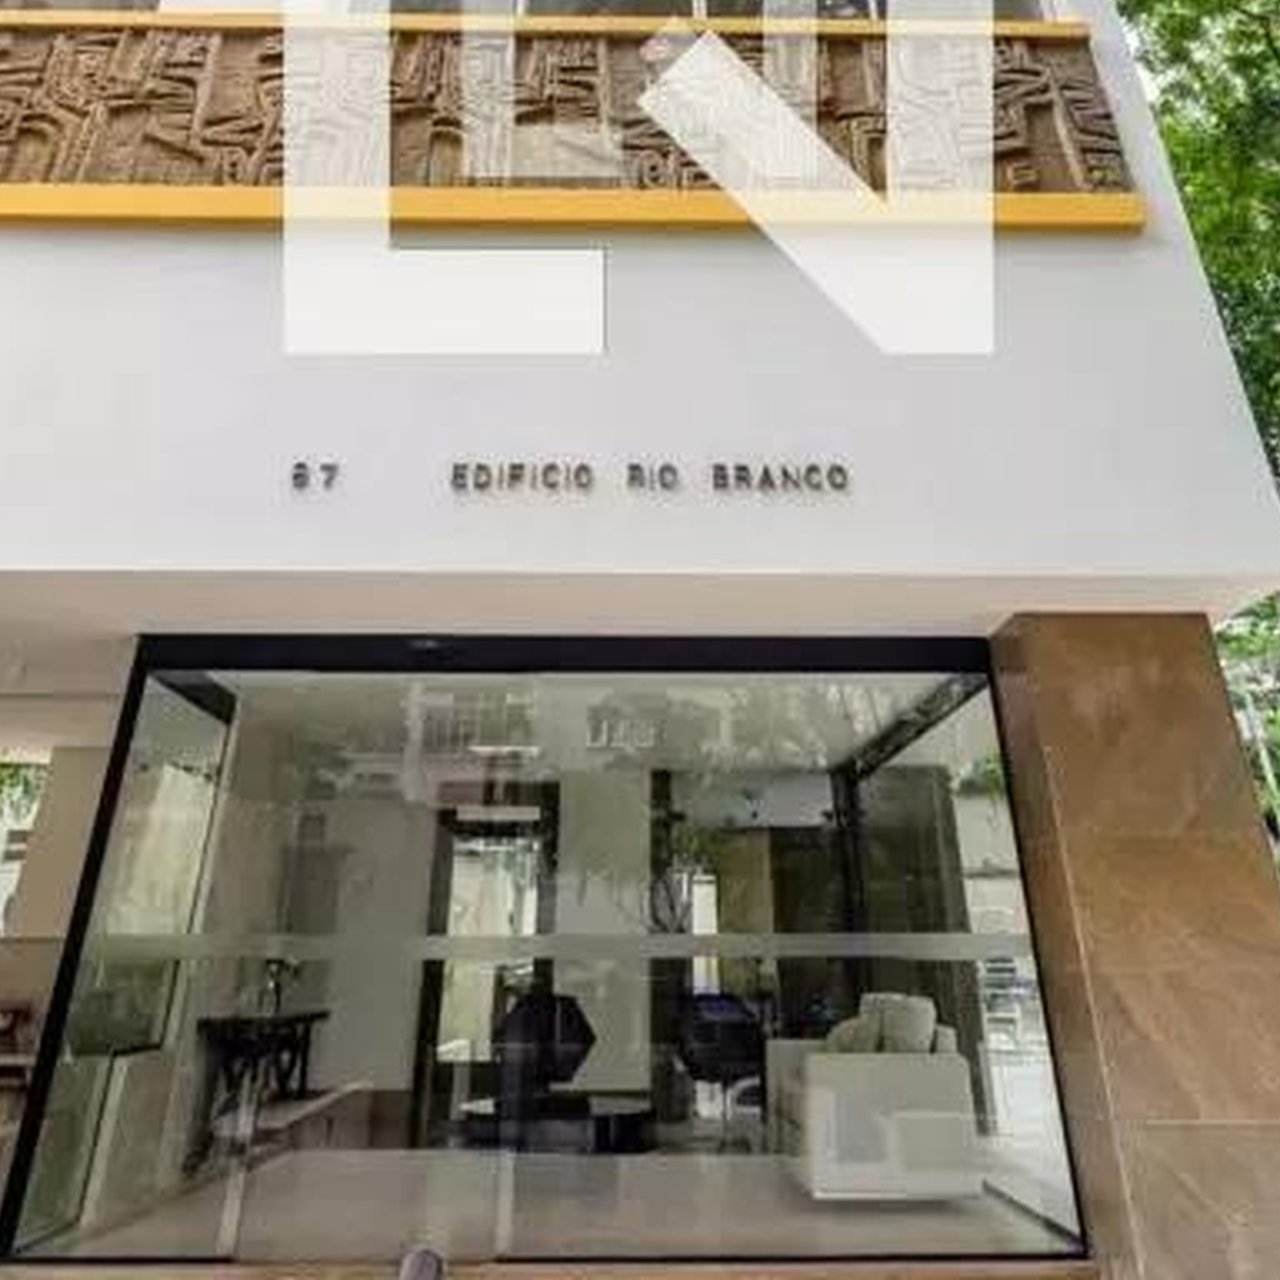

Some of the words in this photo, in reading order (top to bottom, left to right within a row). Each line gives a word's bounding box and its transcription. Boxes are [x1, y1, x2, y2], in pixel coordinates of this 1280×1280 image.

[450, 462, 593, 492] EDIFICIO
[626, 462, 680, 491] RIO
[711, 462, 849, 492] BRANCO
